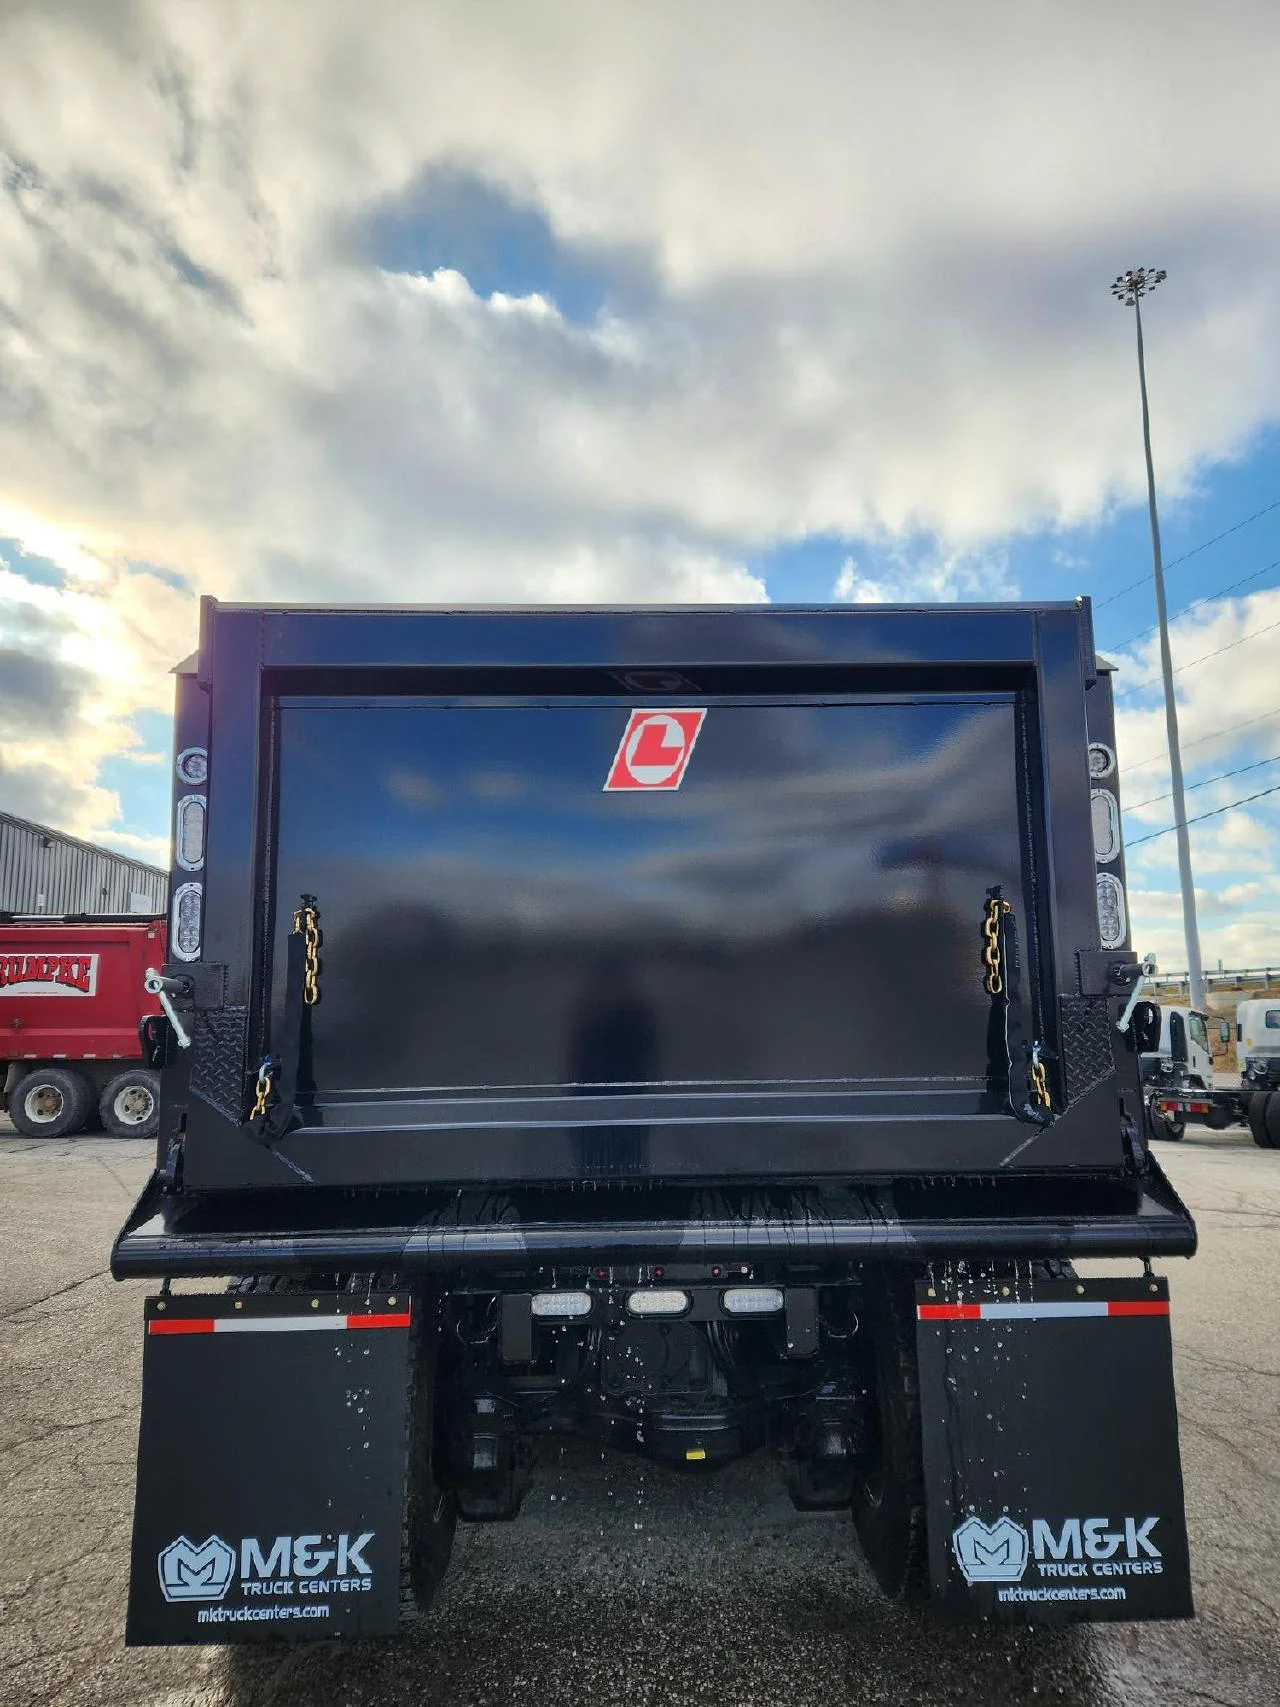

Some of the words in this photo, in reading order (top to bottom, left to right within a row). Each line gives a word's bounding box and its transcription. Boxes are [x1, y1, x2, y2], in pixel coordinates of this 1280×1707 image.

[1032, 1517, 1163, 1560] M&K
[240, 1531, 375, 1579] M&K
[1037, 1563, 1088, 1577] TRUCK
[1092, 1561, 1164, 1576] CENTERS
[241, 1581, 294, 1596] TRUCK
[299, 1578, 372, 1594] CENTERS
[998, 1586, 1127, 1602] mktruckcenters.com
[197, 1604, 330, 1623] mktruckcenters.com
